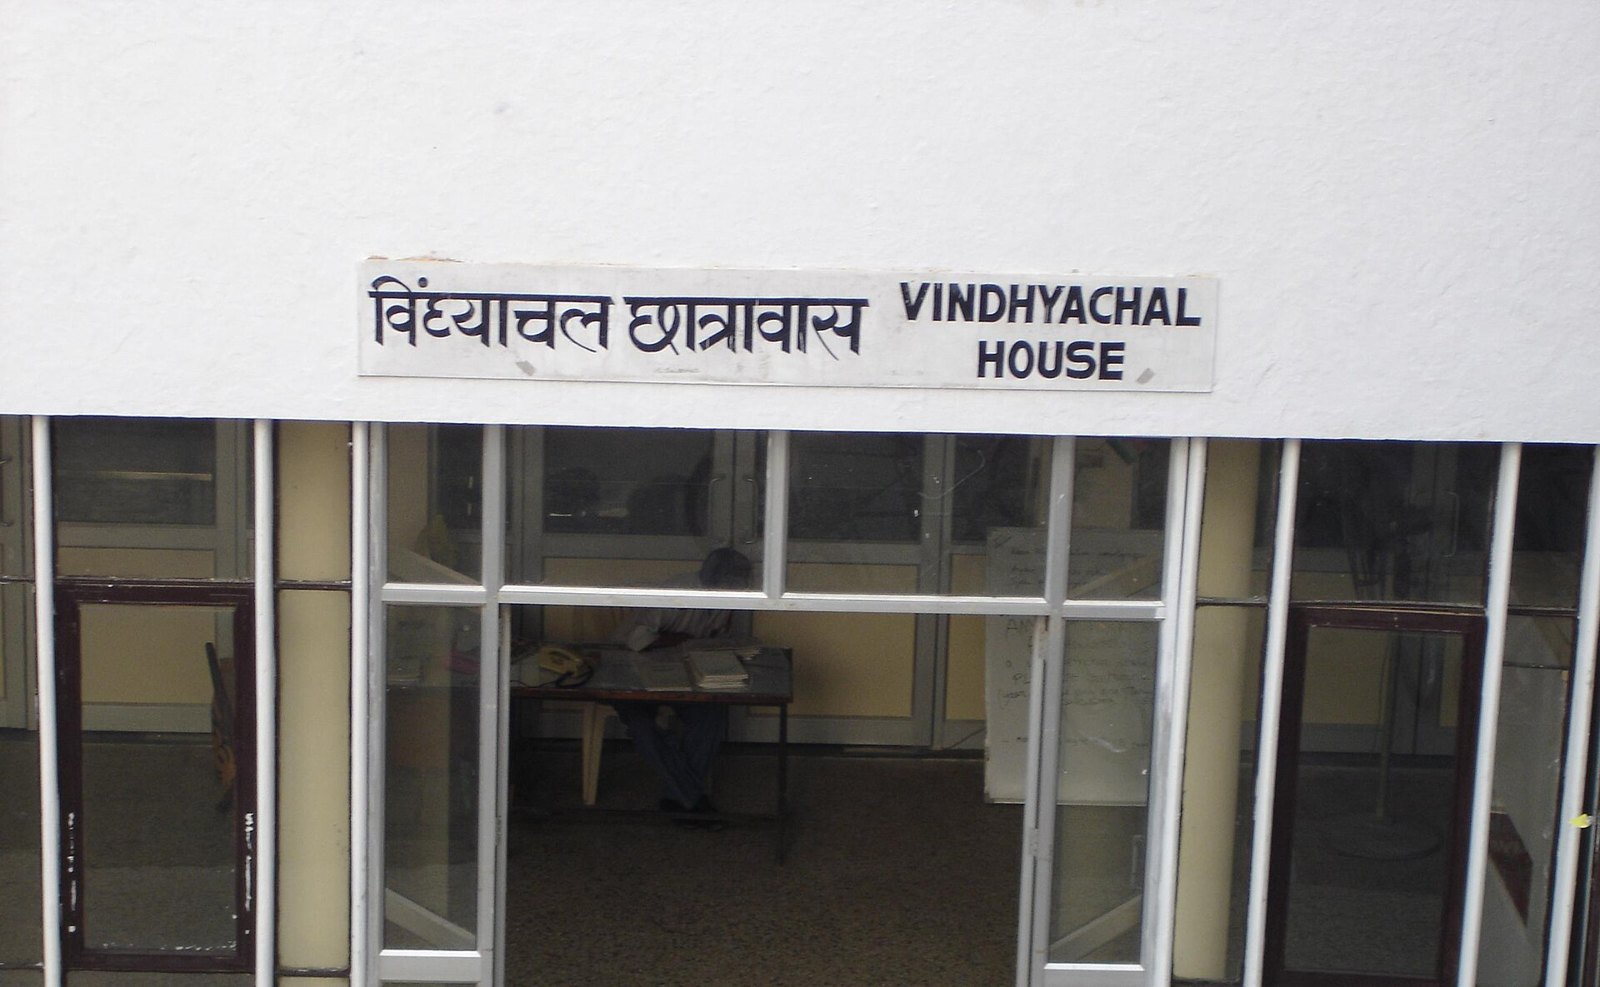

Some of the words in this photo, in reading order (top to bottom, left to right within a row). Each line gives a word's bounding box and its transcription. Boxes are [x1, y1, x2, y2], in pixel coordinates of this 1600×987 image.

[367, 275, 614, 353] विंध्याचल
[622, 296, 869, 361] छात्रावास
[899, 282, 1202, 327] VINDHYACHAL
[977, 341, 1125, 380] HOUSE
